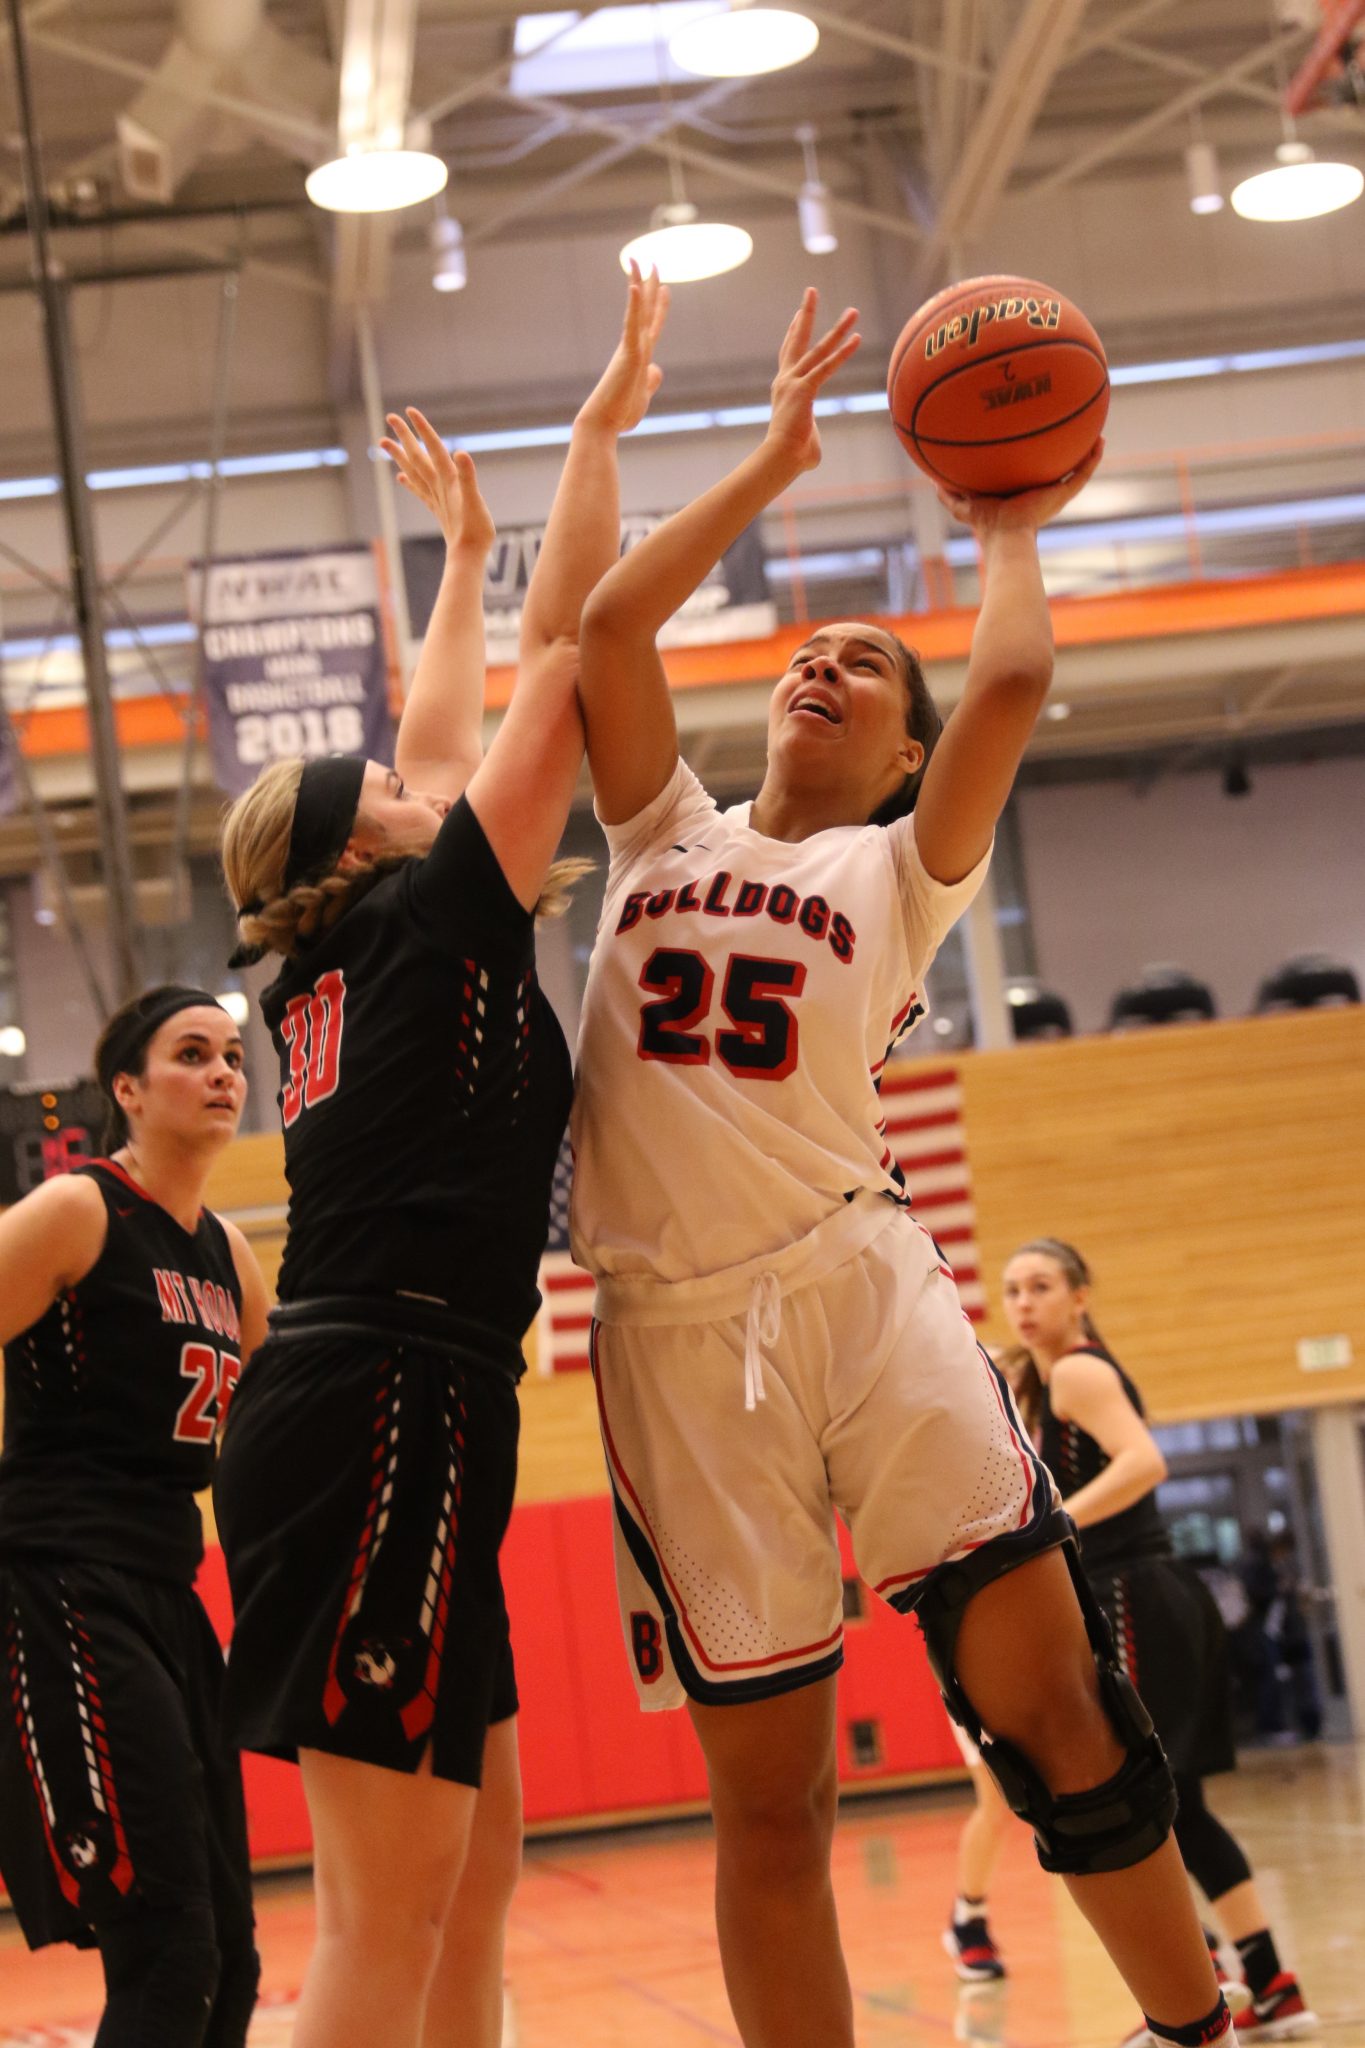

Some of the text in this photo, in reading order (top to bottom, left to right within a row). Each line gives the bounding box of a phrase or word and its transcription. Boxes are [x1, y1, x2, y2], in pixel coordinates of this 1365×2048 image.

[925, 297, 1060, 360] Baden
[203, 613, 375, 662] CHAMPIONS
[236, 705, 365, 764] 2018
[615, 871, 857, 965] BULLDOGS
[281, 968, 347, 1129] 30
[637, 947, 808, 1082] 25
[152, 1268, 197, 1326] MT
[630, 1610, 664, 1685] B
